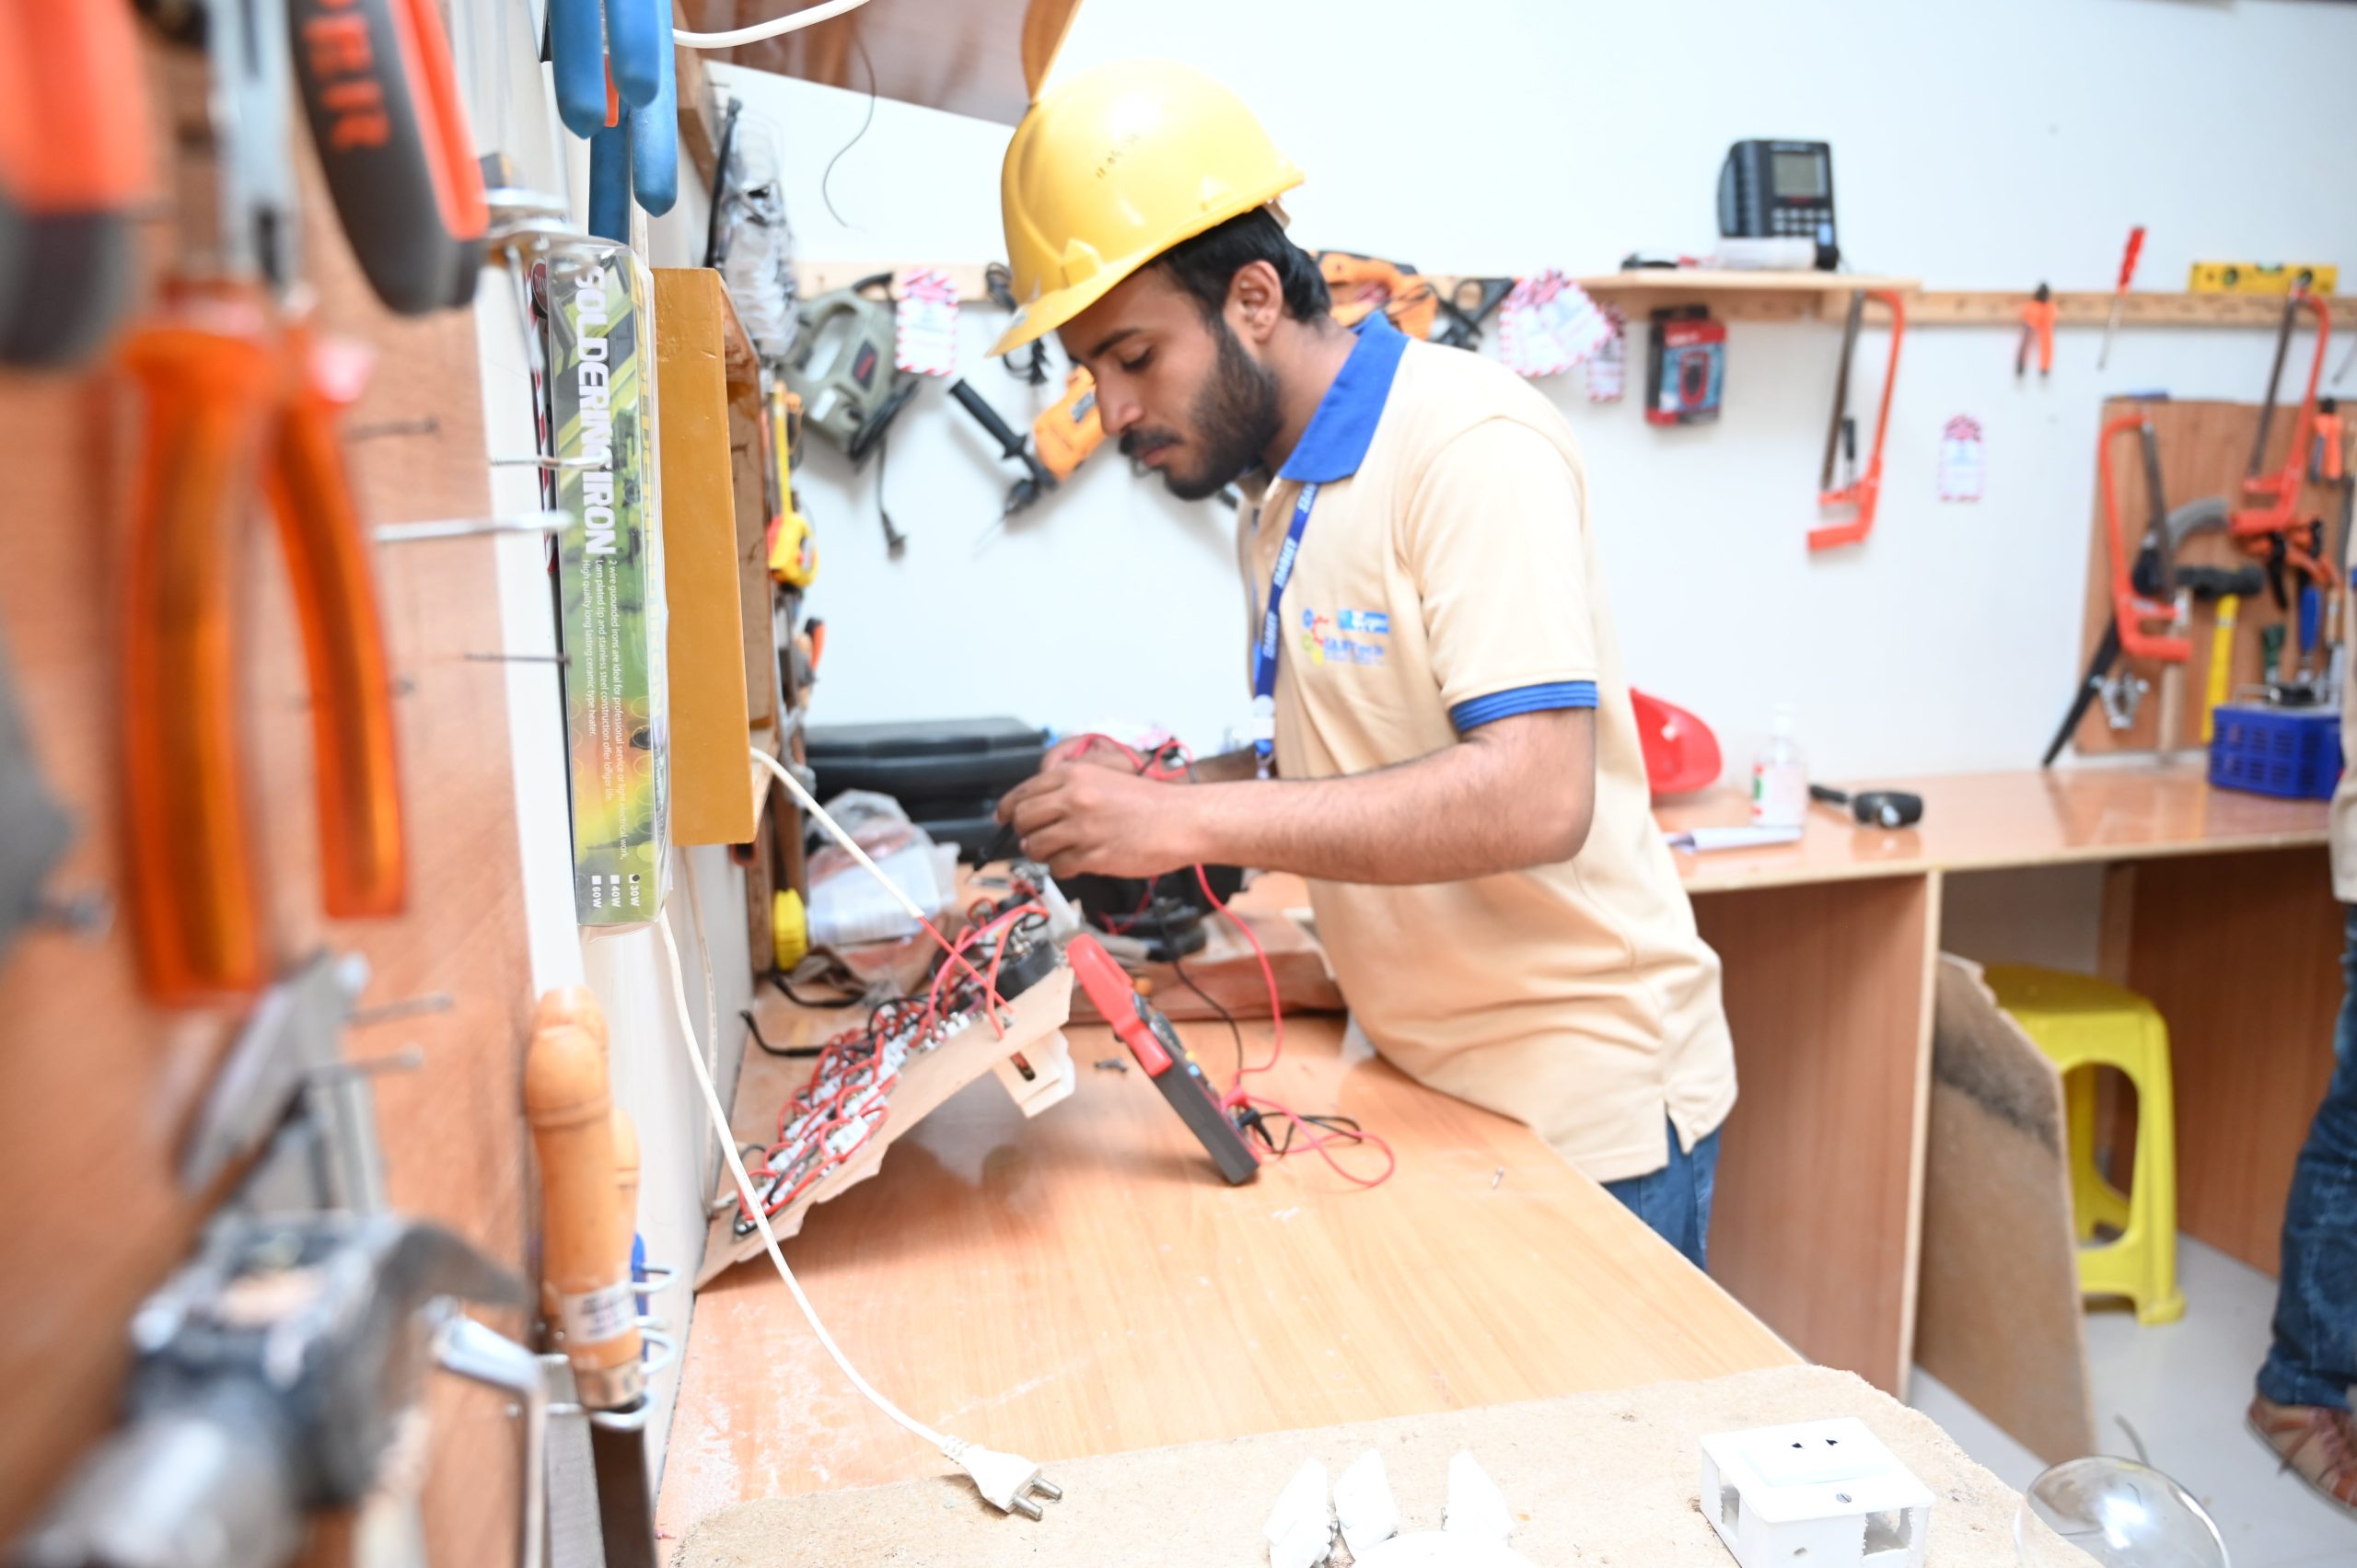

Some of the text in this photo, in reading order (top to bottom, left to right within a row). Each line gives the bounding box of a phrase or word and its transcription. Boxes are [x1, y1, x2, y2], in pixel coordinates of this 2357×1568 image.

[582, 471, 617, 555] IRON
[609, 566, 618, 584] wire
[595, 580, 605, 605] plated
[596, 607, 606, 618] tip
[608, 586, 619, 627] guounded
[598, 619, 608, 634] and
[580, 560, 597, 736] High quality long lasting ceramic type heater.
[611, 629, 620, 648] irons
[599, 636, 609, 669] stainless
[600, 671, 609, 690] steel
[613, 664, 622, 682] ideal
[614, 685, 623, 695] for
[601, 691, 612, 739] construction
[612, 697, 624, 744] professional
[604, 743, 612, 760] offer
[616, 746, 625, 772] service
[603, 762, 613, 786] longer
[617, 774, 625, 782] or
[615, 784, 627, 801] light
[619, 804, 628, 837] electrical
[619, 839, 629, 859] work,
[592, 886, 601, 908] 60W
[612, 886, 621, 907] 40W
[630, 885, 640, 906] 30W
